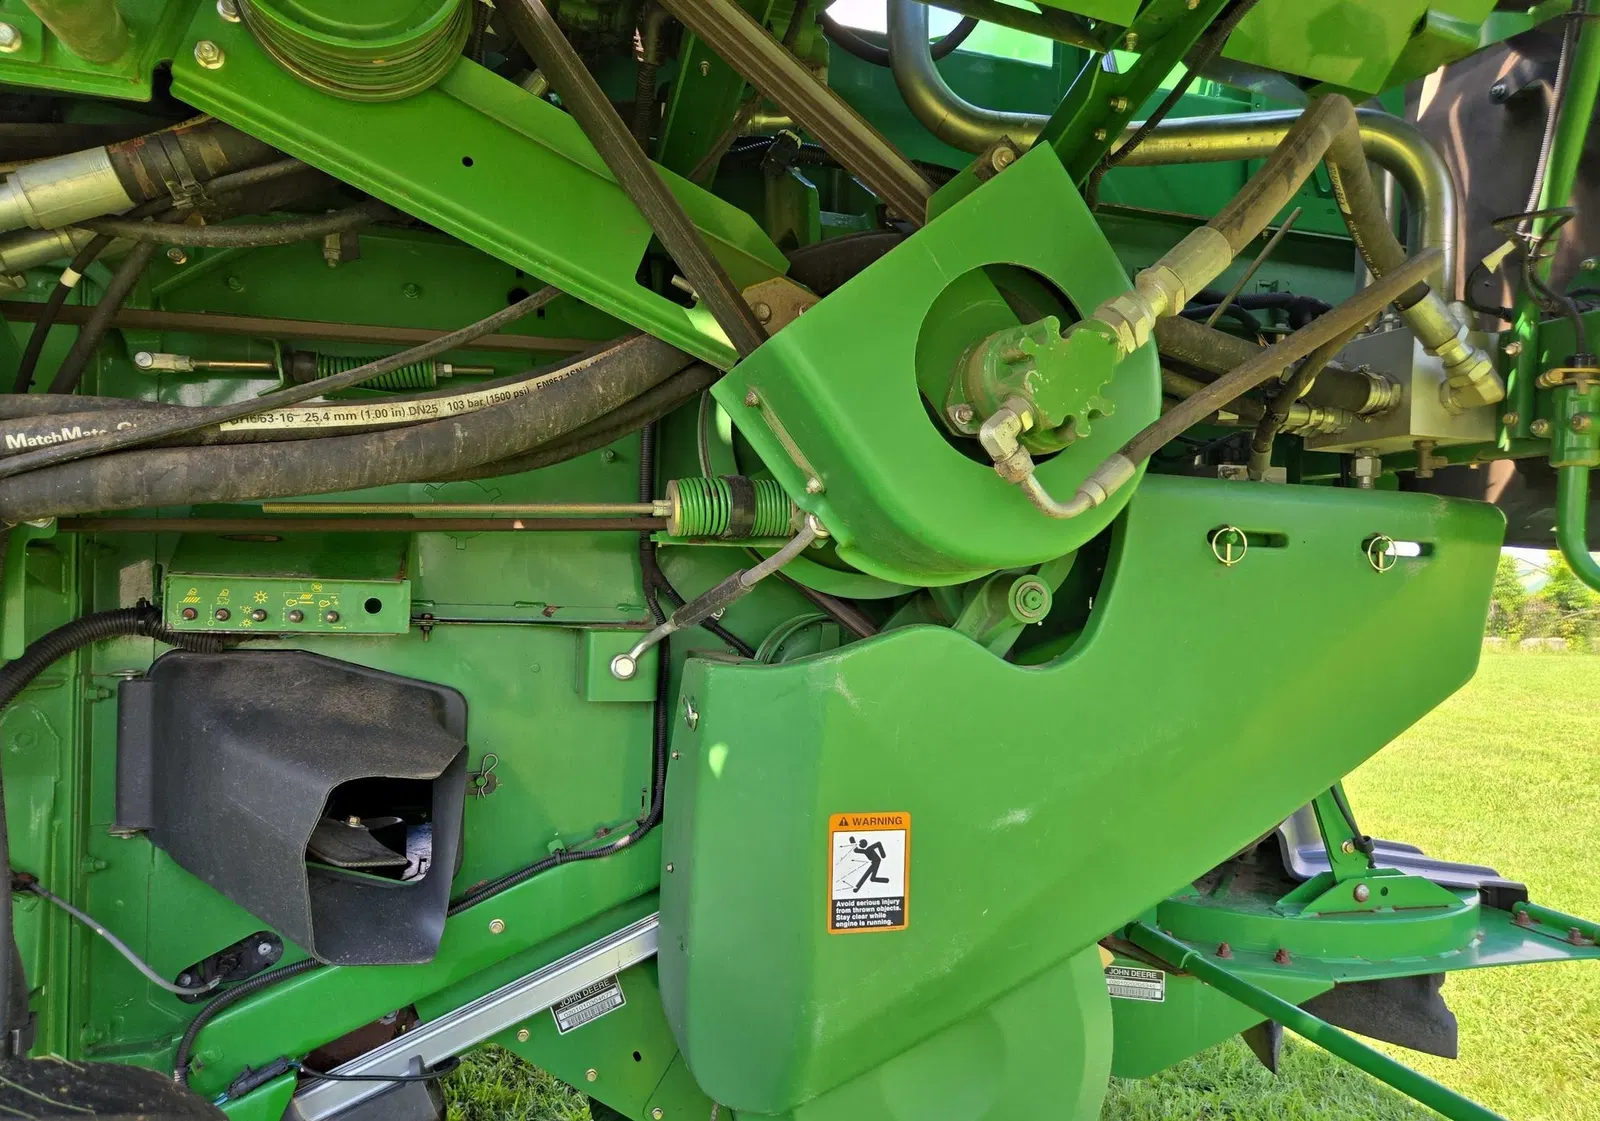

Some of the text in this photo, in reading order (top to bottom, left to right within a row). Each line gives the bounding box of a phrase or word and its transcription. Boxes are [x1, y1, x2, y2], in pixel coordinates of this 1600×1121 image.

[305, 410, 330, 422] 25.4
[333, 412, 357, 421] mm
[390, 406, 406, 418] in)
[408, 404, 439, 416] DN25
[447, 400, 465, 411] 103
[467, 397, 483, 408] bar
[486, 391, 511, 406] (1500
[513, 386, 530, 402] psi)
[852, 816, 903, 826] WARNING
[1130, 970, 1156, 978] DEERE
[559, 979, 610, 1007] JOHN DEERE
